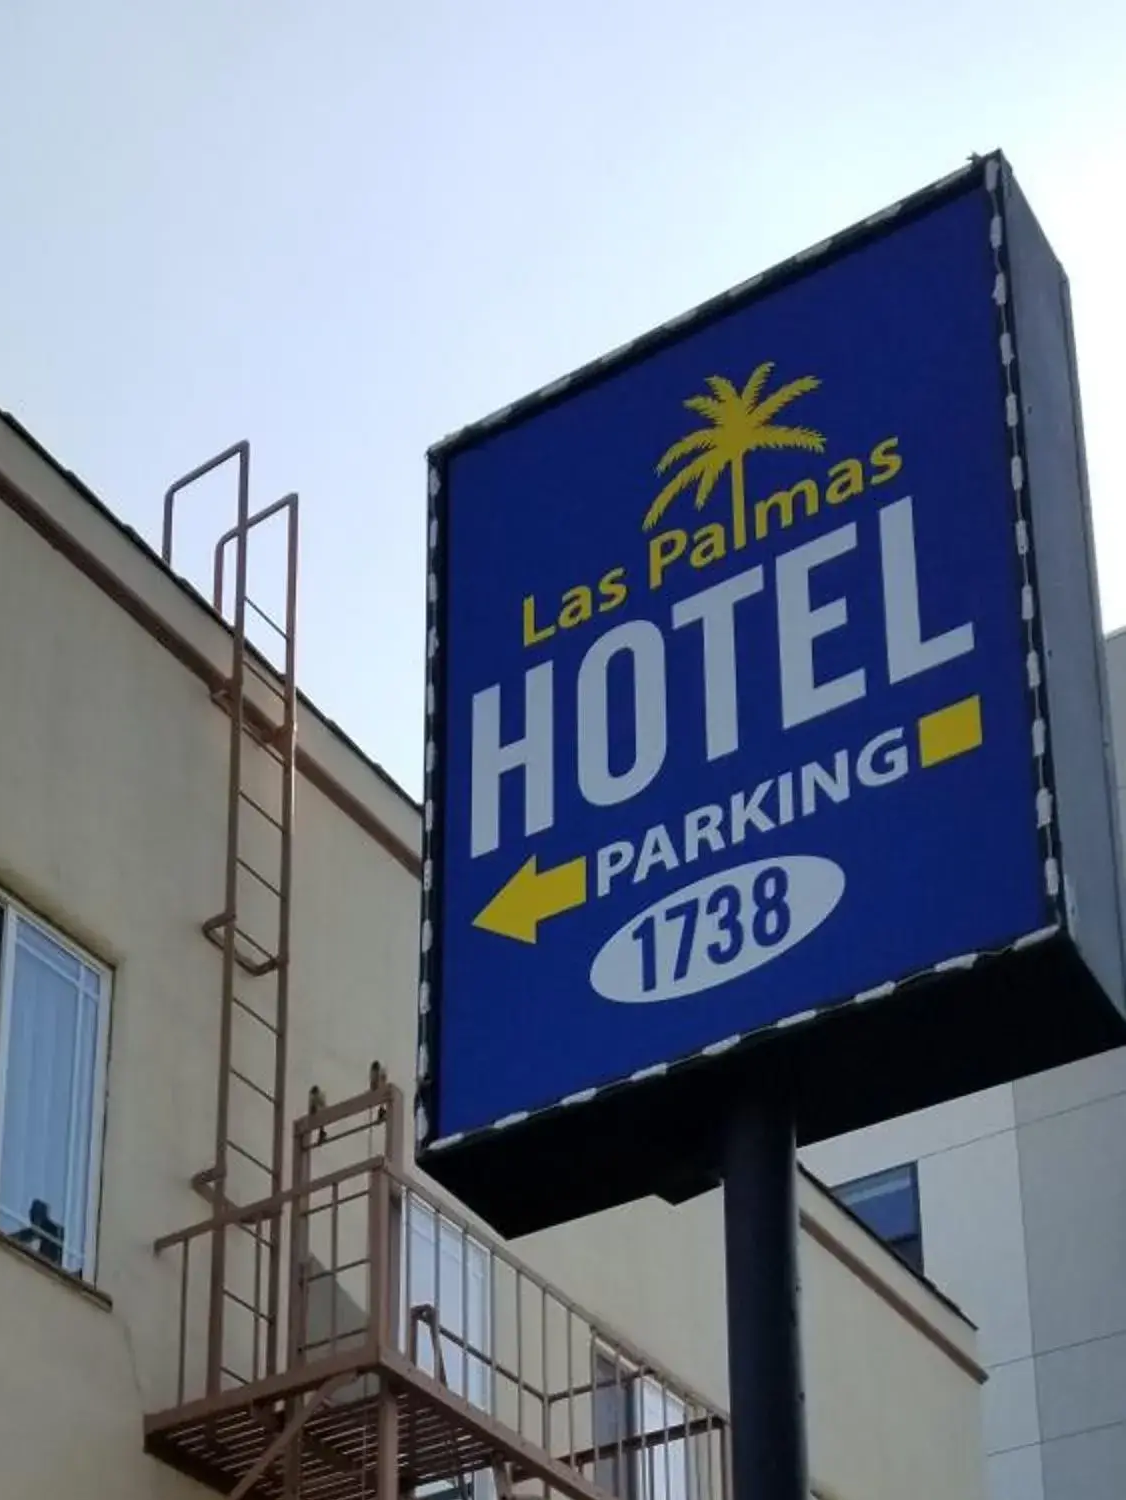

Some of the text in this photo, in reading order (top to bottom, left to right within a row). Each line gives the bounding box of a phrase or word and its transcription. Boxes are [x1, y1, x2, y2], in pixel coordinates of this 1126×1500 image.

[524, 436, 904, 647] Las Palmas
[471, 495, 975, 858] HOTEL
[595, 726, 910, 897] PARKING
[631, 865, 793, 994] 1738
